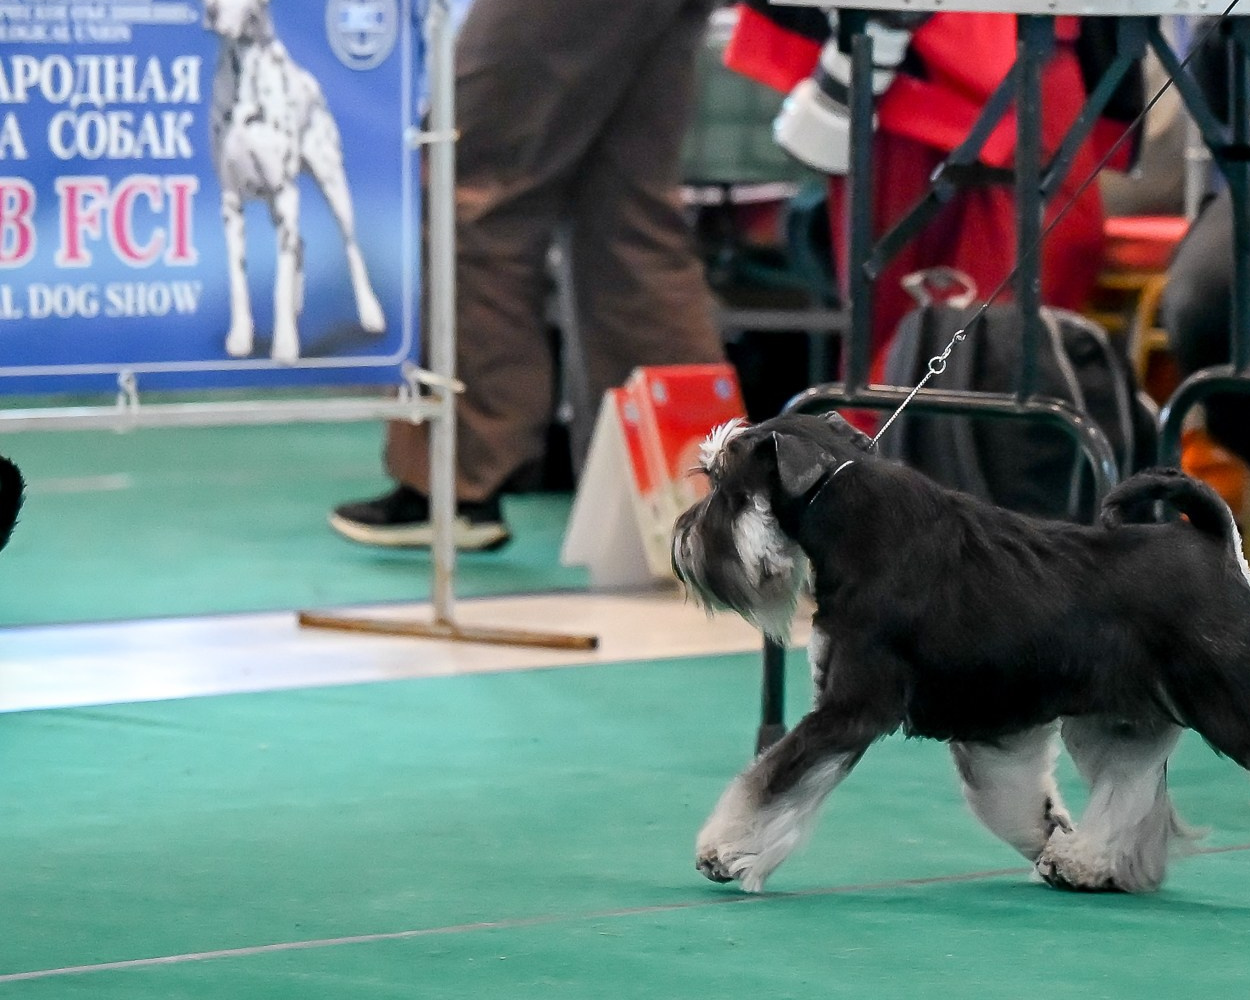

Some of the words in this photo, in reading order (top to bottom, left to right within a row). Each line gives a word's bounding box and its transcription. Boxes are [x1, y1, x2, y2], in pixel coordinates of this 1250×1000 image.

[48, 110, 194, 160] СОБАК
[54, 173, 200, 269] FCI
[28, 282, 101, 320] DOG
[105, 280, 202, 319] SHOW
